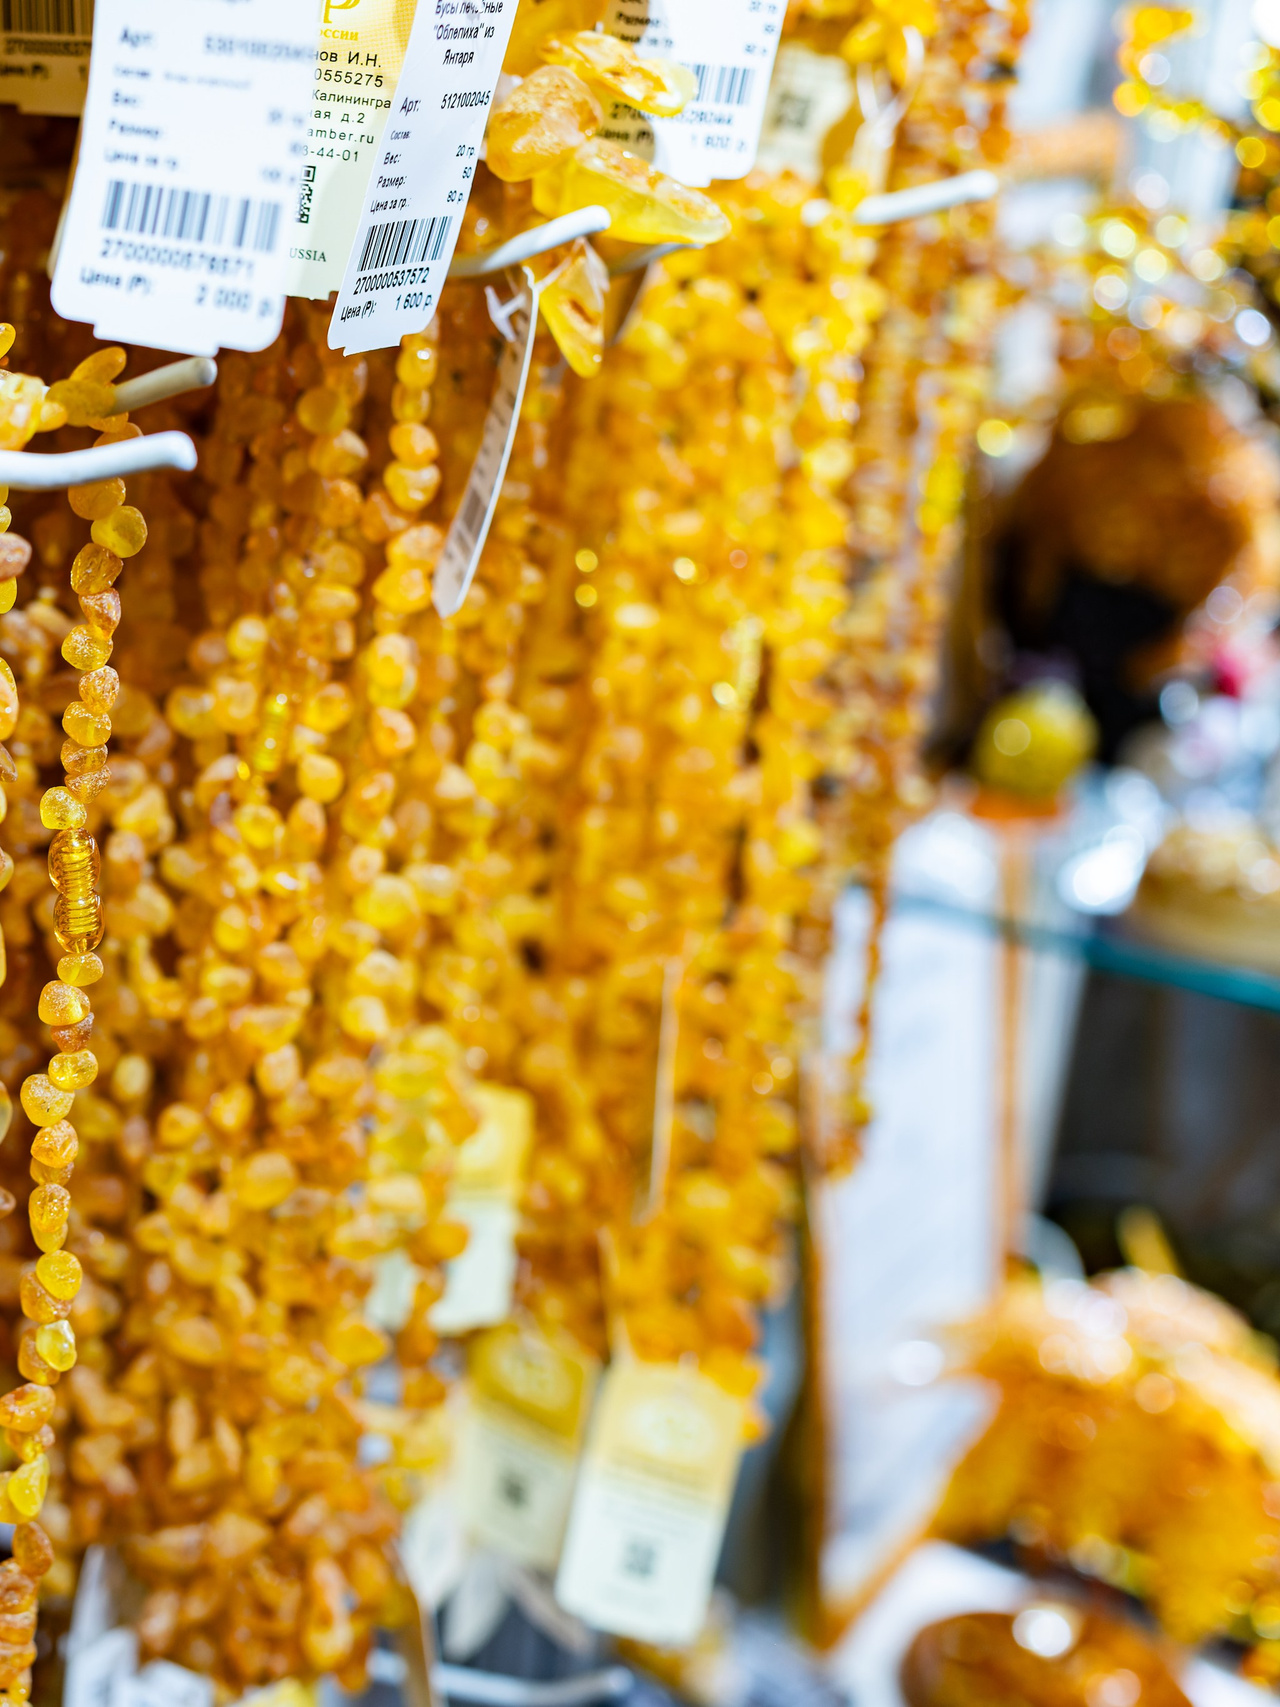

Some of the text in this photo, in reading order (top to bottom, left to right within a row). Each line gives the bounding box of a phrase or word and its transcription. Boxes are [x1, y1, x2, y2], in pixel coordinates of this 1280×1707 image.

[435, 0, 459, 19] Бусы
[433, 23, 495, 41] "Облепиха" из
[347, 50, 382, 68] И.Н.
[442, 48, 475, 68] Янтаря
[313, 67, 384, 88] 0555275
[399, 90, 491, 117] Арт: 5121002045
[340, 111, 366, 124] д.2
[307, 127, 375, 144] amber.ru
[383, 151, 402, 165] Вес:
[455, 144, 466, 157] 20
[376, 166, 473, 189] Размер: 50
[370, 199, 389, 215] Цена
[388, 200, 397, 210] за
[353, 266, 430, 296] 2700000537572
[340, 304, 361, 322] Цена
[361, 300, 377, 319] (Р):
[395, 294, 402, 311] 1
[403, 291, 423, 310] 600
